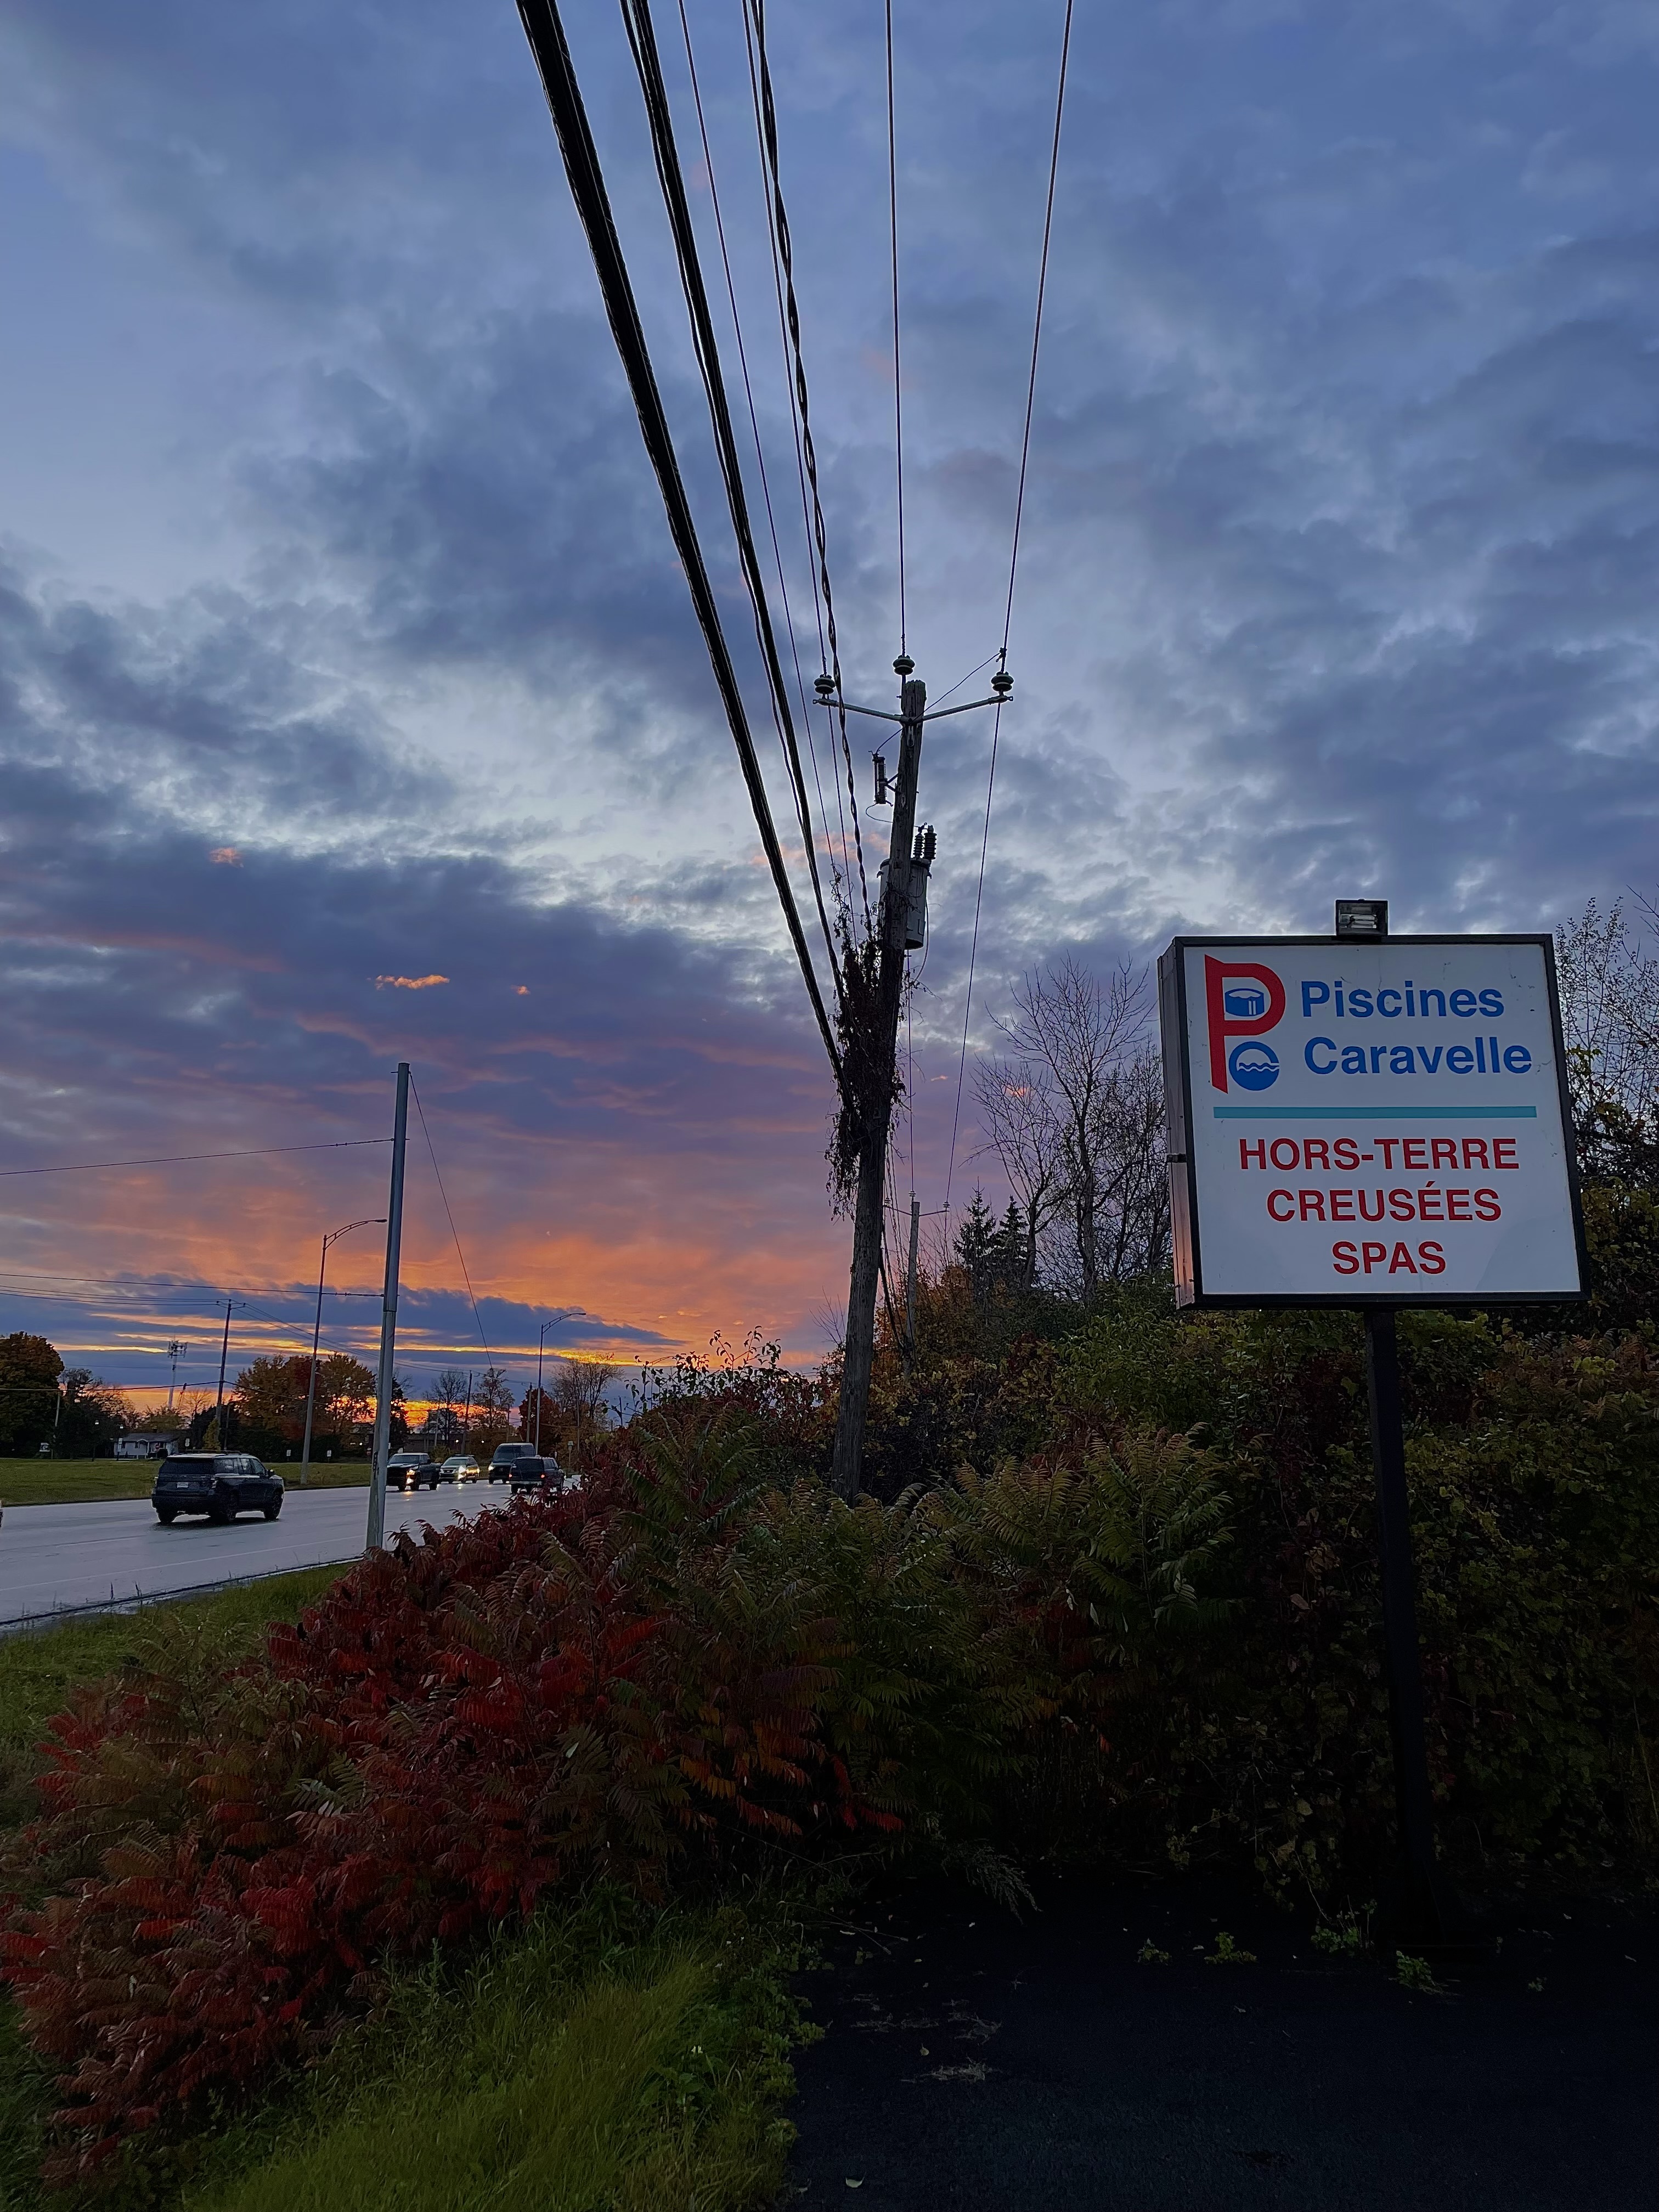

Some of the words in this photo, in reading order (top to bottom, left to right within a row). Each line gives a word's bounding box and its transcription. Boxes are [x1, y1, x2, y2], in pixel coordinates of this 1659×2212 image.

[1301, 981, 1504, 1017] Piscines
[1304, 1036, 1532, 1075] Caravelle
[1239, 1138, 1519, 1171] HORS-TERRE
[1267, 1181, 1501, 1222] CREUSÉES
[1332, 1241, 1446, 1274] SPAS
